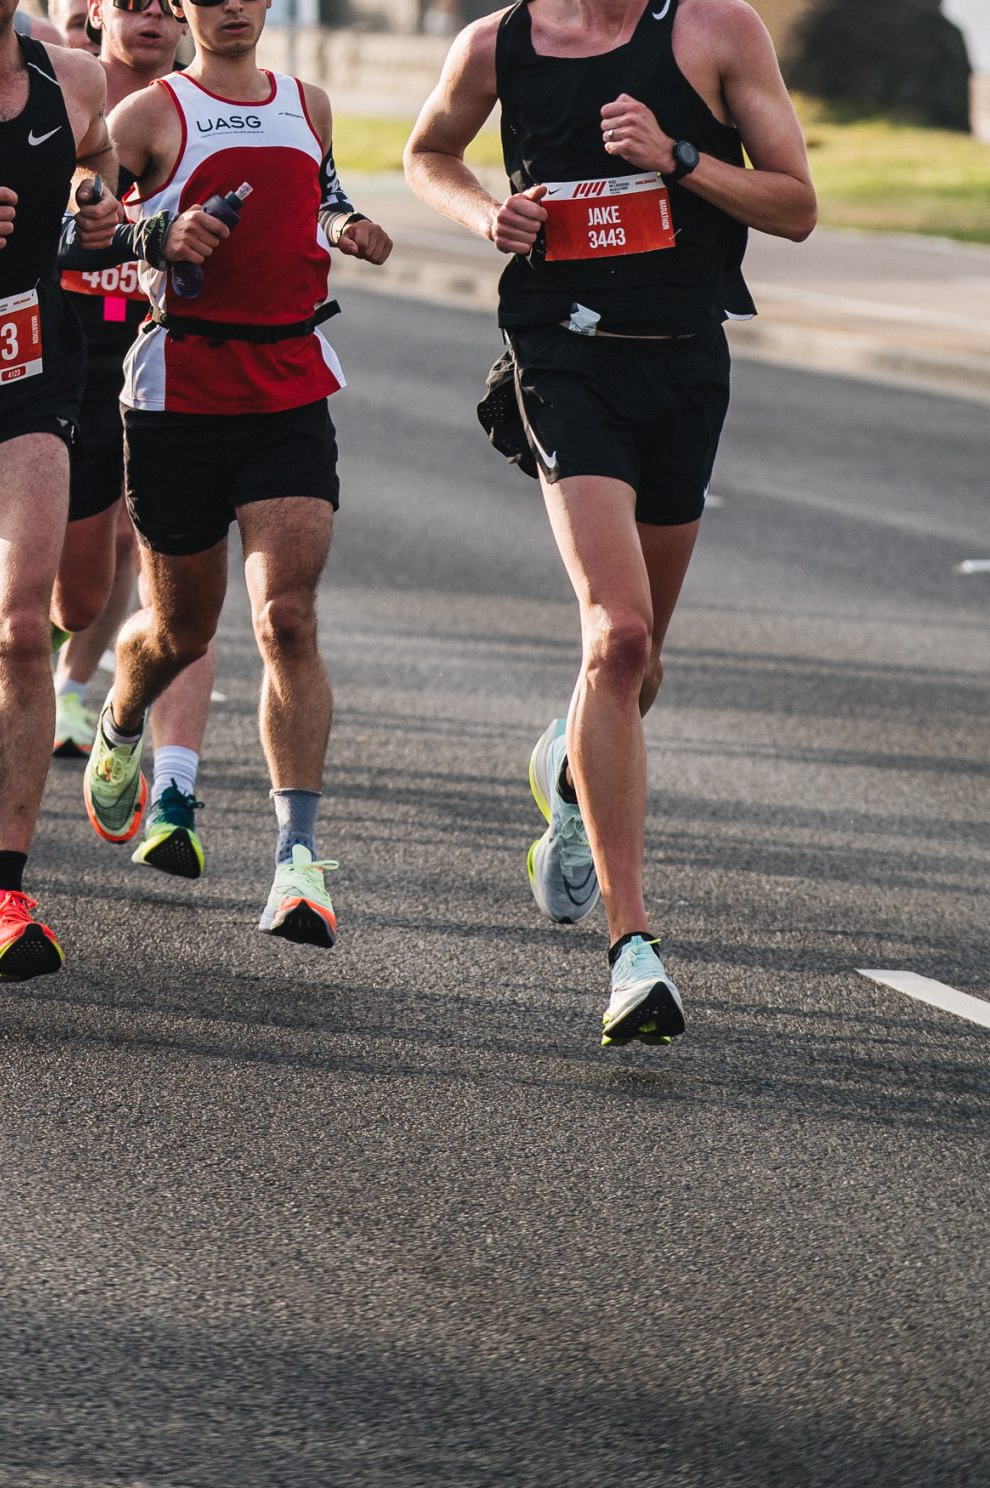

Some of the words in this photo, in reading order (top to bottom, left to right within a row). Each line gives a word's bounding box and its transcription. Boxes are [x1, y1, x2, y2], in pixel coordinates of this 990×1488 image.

[196, 115, 262, 133] UASG
[587, 205, 622, 226] JAKE
[588, 227, 627, 249] 3443
[82, 261, 146, 294] 465
[8, 368, 21, 379] 4123
